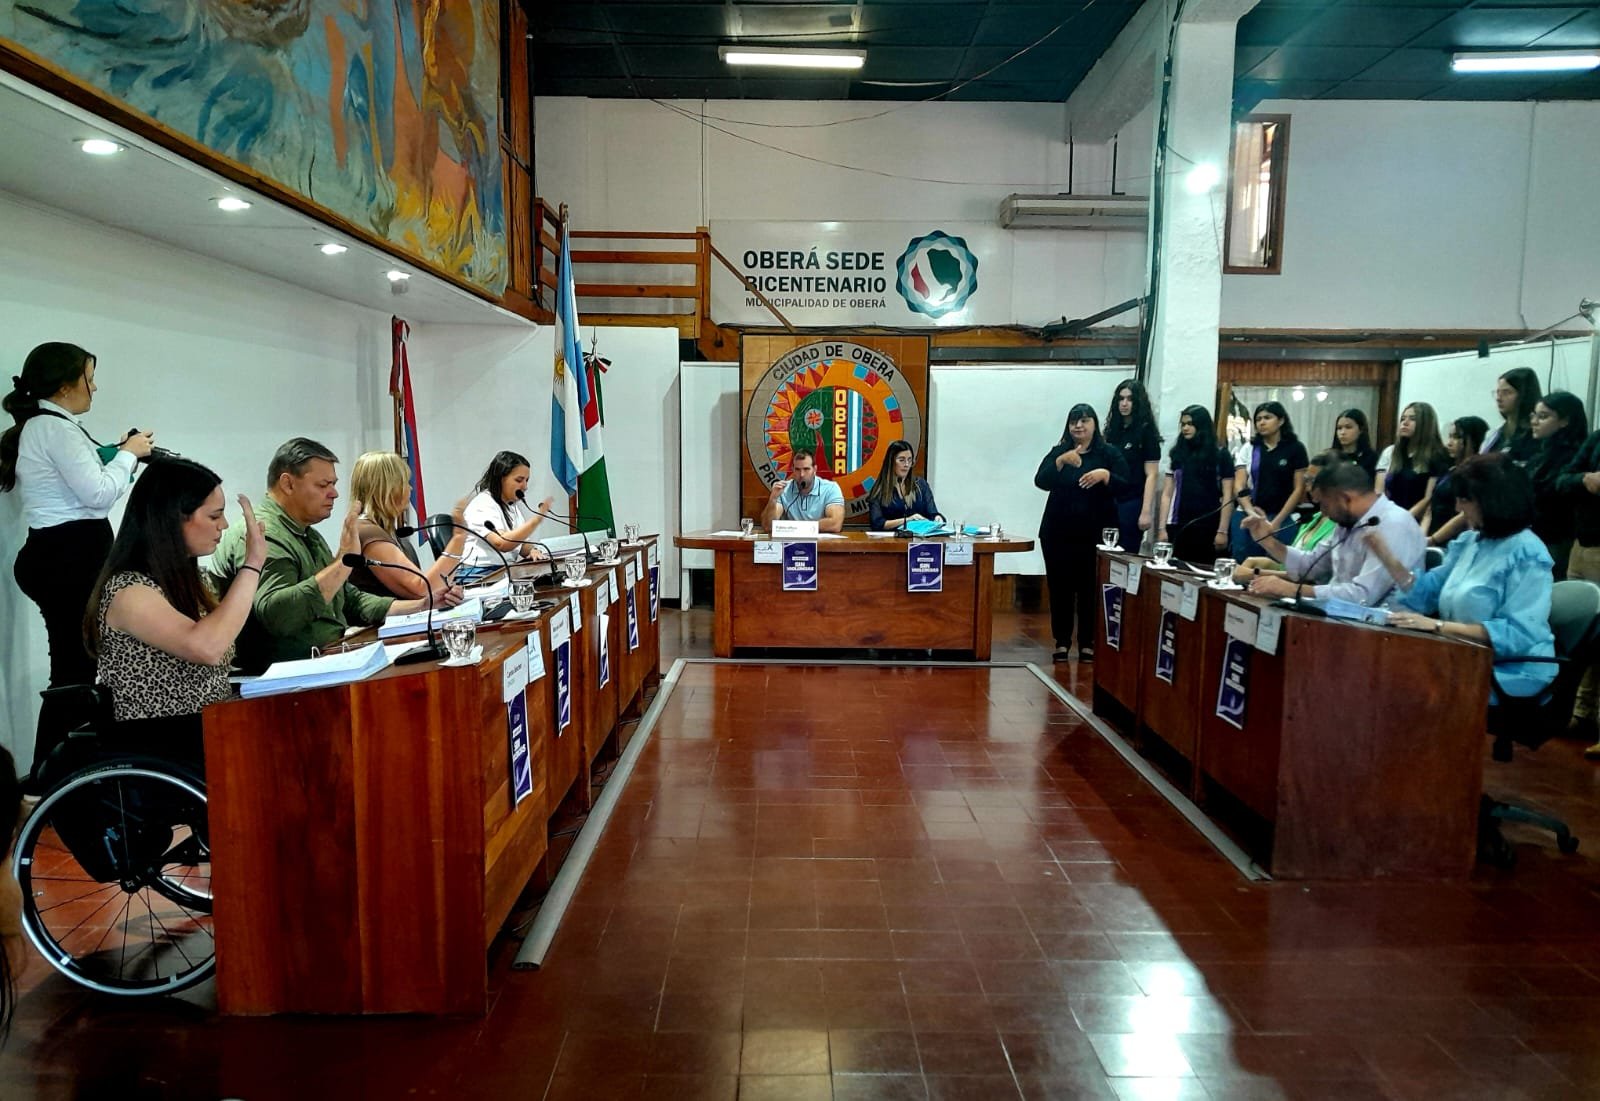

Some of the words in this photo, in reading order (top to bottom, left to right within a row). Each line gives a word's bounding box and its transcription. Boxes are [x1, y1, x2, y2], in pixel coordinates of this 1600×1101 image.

[743, 246, 820, 269] OBERÁ
[826, 252, 885, 270] SEDE
[744, 276, 887, 293] BICENTENARIO
[745, 297, 829, 308] MUICIPALIDAD
[832, 299, 847, 308] DE
[849, 296, 886, 308] OBERÁ
[773, 347, 819, 380] CIUDAD
[825, 345, 843, 357] DE
[851, 348, 895, 381] OBERA
[835, 389, 846, 474] OBERA
